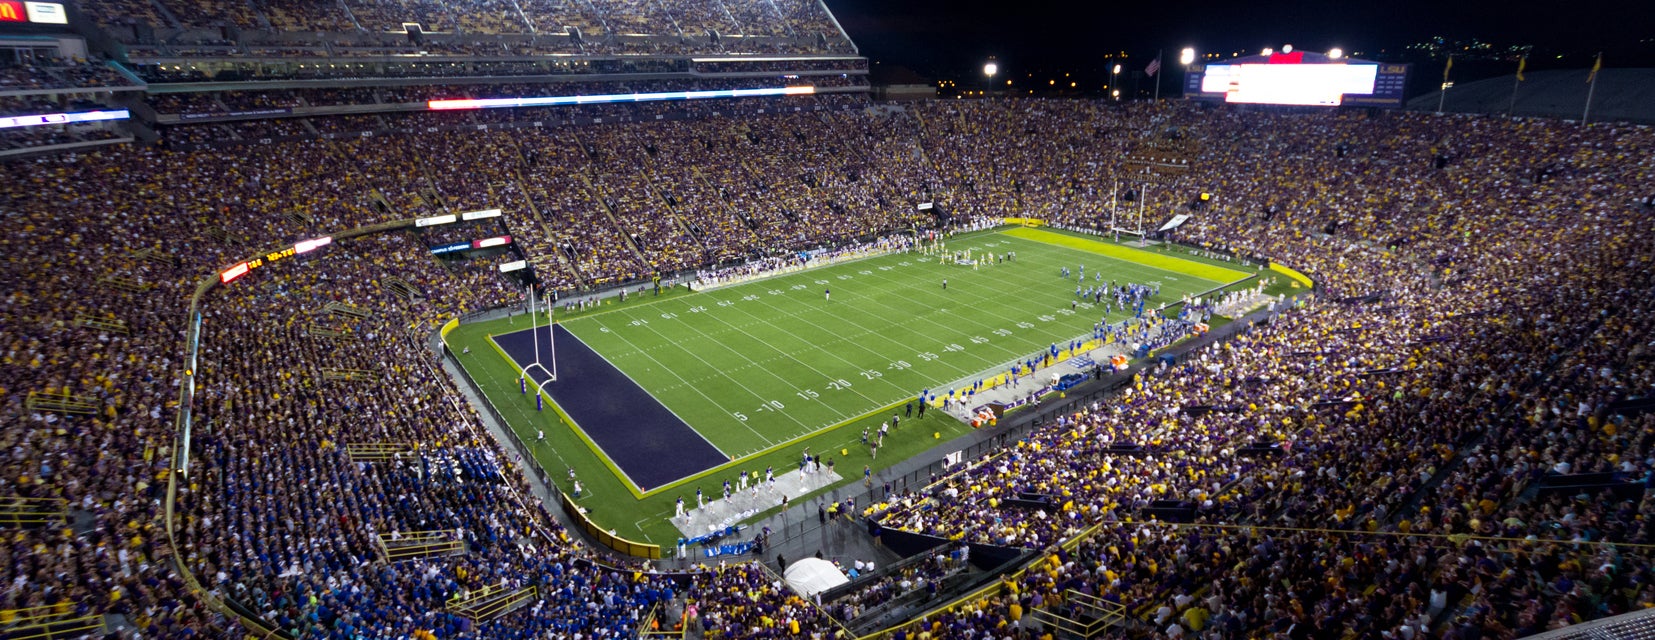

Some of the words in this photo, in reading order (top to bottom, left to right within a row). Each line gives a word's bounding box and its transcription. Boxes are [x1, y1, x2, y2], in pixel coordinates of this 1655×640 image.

[1380, 65, 1405, 74] LSU
[689, 305, 708, 313] 20
[631, 318, 648, 326] 10
[944, 343, 965, 352] 40
[917, 351, 939, 361] 35
[889, 360, 912, 370] 30
[860, 369, 883, 380] 25
[829, 379, 852, 391] 20
[796, 389, 819, 401] 15
[761, 400, 785, 412] 10
[733, 411, 749, 422] 5
